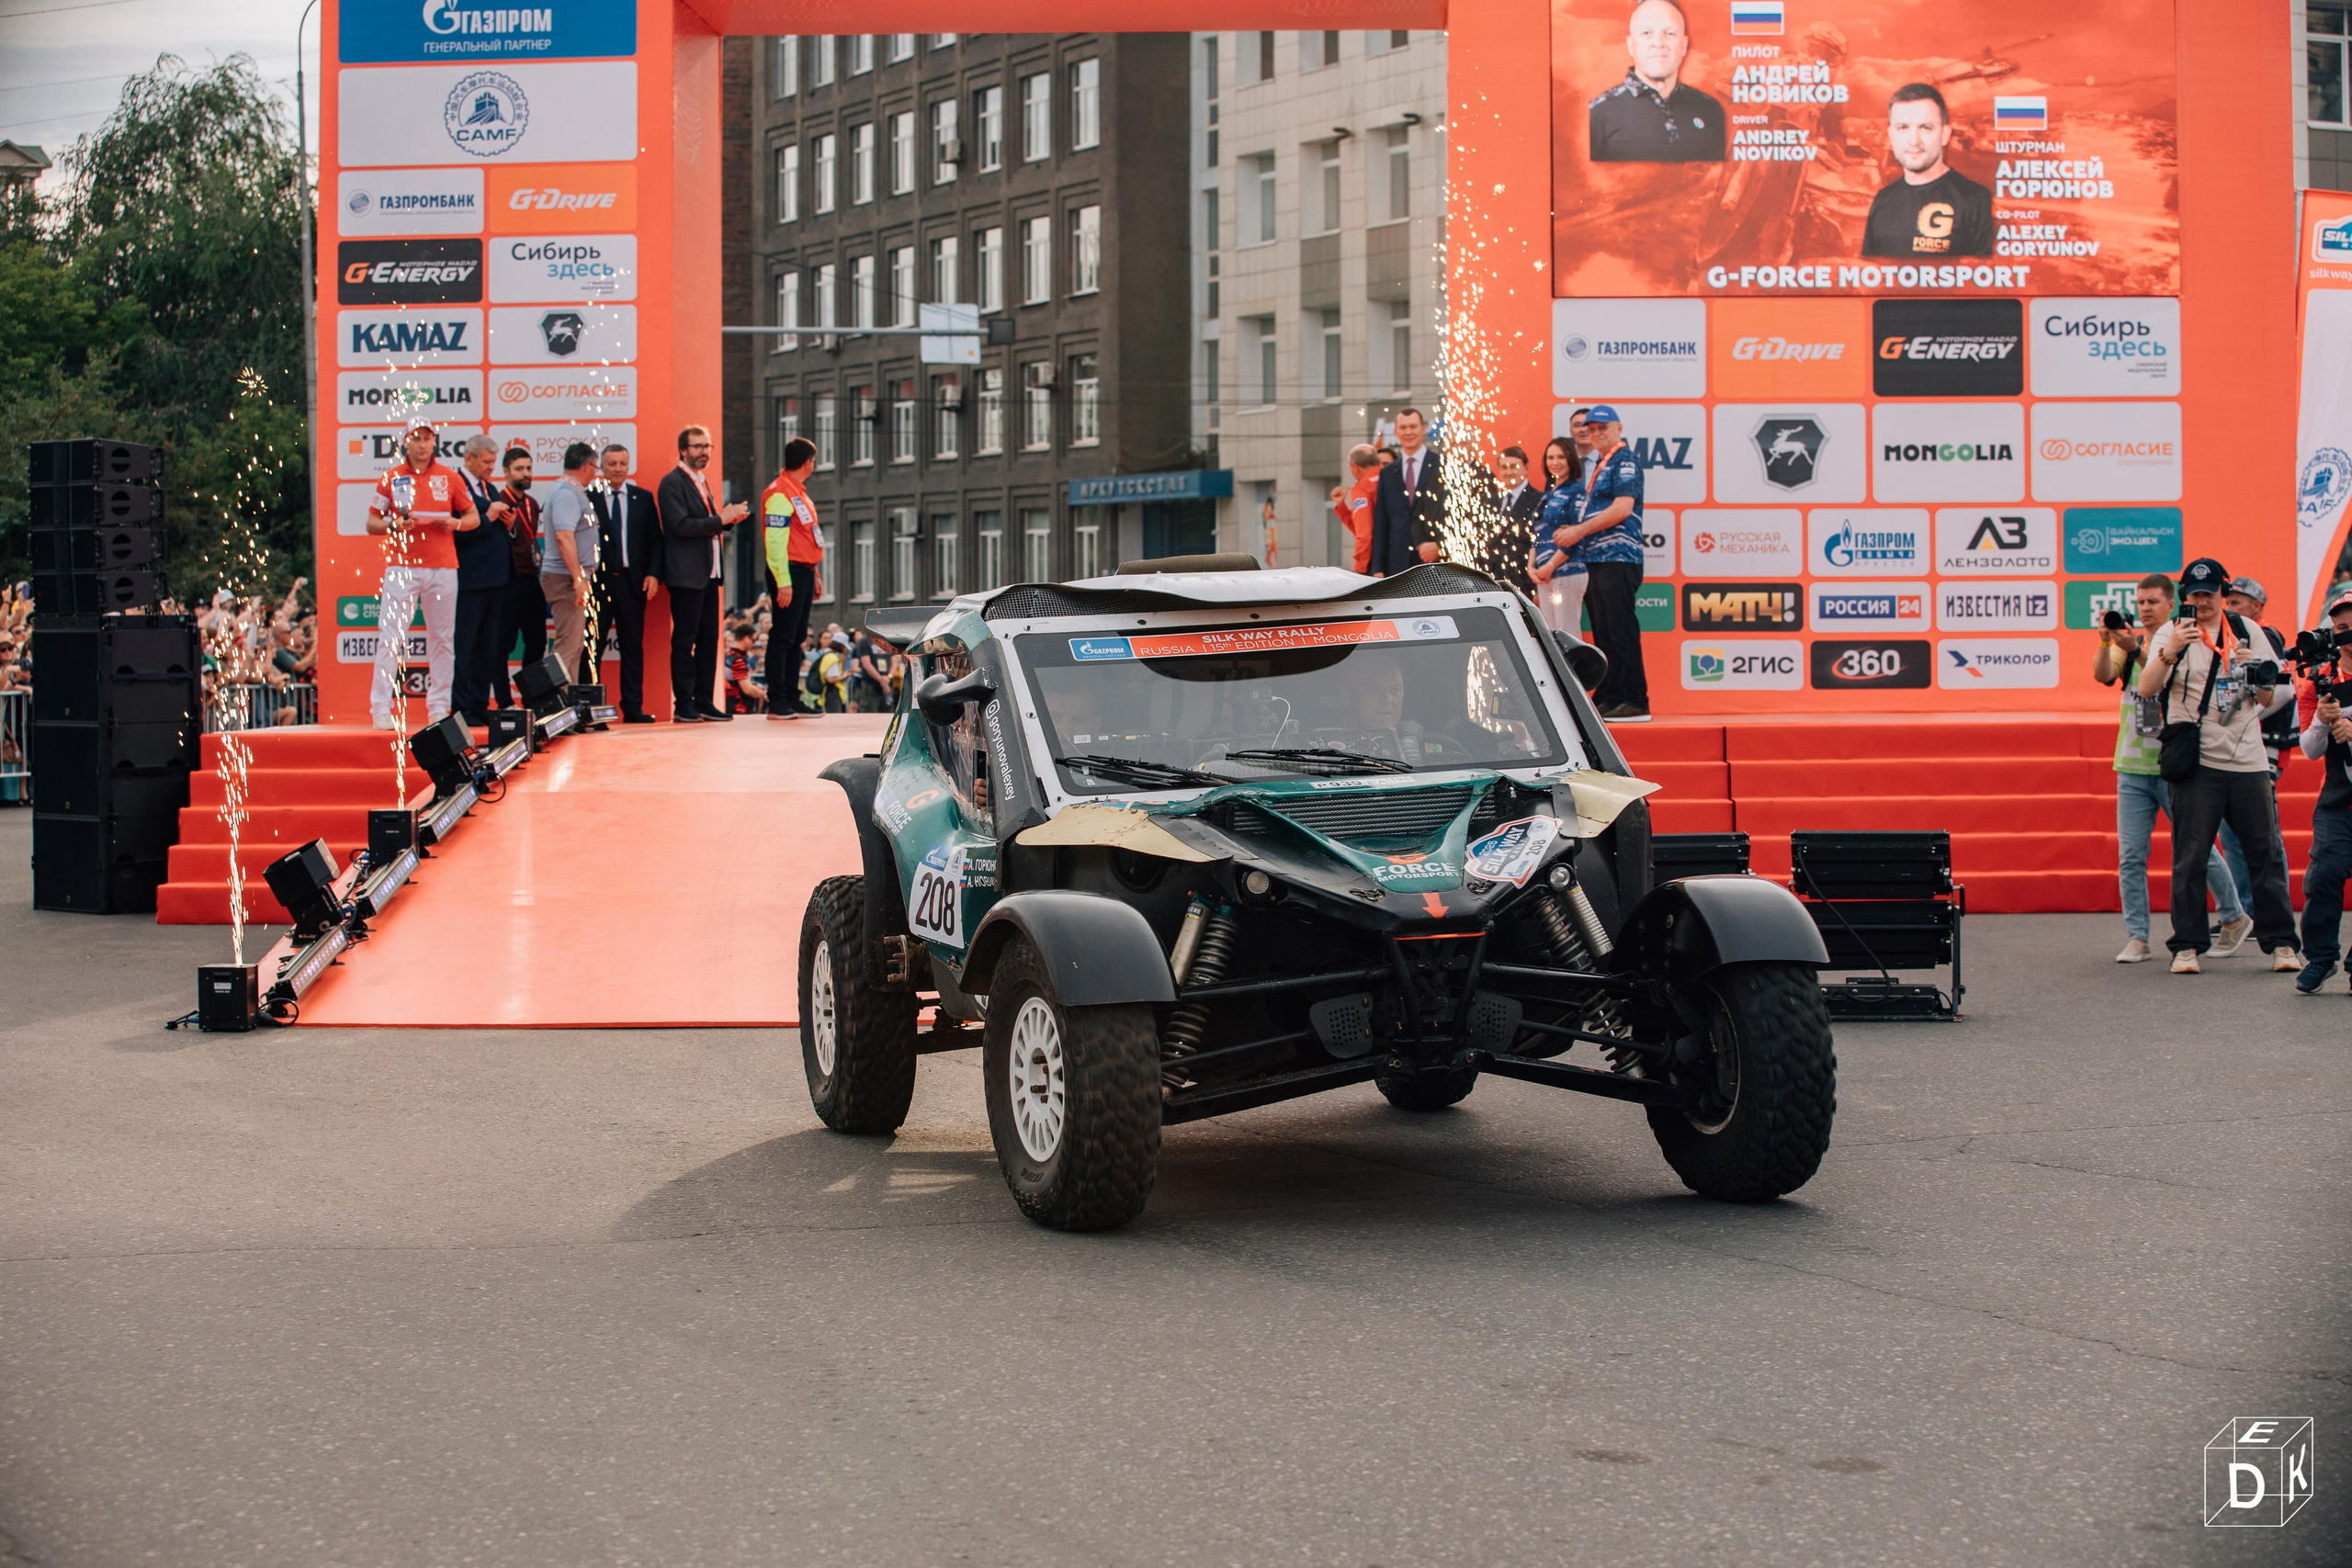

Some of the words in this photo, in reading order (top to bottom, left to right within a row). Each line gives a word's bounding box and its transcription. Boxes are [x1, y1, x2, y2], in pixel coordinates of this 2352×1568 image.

[461, 8, 552, 34] ГАЗПРОМ
[424, 39, 502, 53] ГЕНЕРАЛЬНЫЙ
[504, 39, 551, 51] ПАРТНЕР
[1732, 46, 1781, 58] ПИЛОТ
[1732, 61, 1830, 85] АНДРЕЙ
[1732, 85, 1849, 104] НОВИКОВ
[1732, 116, 1769, 125] DRIVER
[457, 129, 516, 141] CAMF
[1732, 130, 1810, 145] ANDREY
[1732, 146, 1817, 162] NOVIKOV
[1996, 141, 2065, 153] ШТУРМАН
[1996, 156, 2104, 179] АЛЕКСЕЙ
[1996, 180, 2114, 199] ГОРЮНОВ
[379, 195, 475, 209] ГАЗПРОМБАНК
[1996, 210, 2041, 220] CO-PILOT
[1996, 224, 2068, 240] ALEXEY
[2323, 230, 2352, 243] SIL
[1913, 236, 1951, 249] FORCE
[1996, 241, 2099, 256] GORYUNOV
[512, 243, 601, 264] Сибирь
[548, 263, 615, 281] здесь
[1707, 265, 1832, 288] G-FORCE
[1838, 265, 2030, 288] MOTORSPORT
[2044, 315, 2150, 341] Сибирь
[353, 322, 468, 353] KAMAZ
[1598, 342, 1696, 355] ГАЗПРОМБАНК
[2087, 341, 2167, 360] здесь
[348, 387, 471, 405] MONGOLIA
[532, 384, 628, 399] СОГЛАСИЕ
[1621, 437, 1693, 469] MAZ
[1884, 444, 2013, 461] MONGOLIA
[2075, 443, 2174, 457] СОГЛАСИЕ
[1080, 475, 1186, 497] ИРКУТСКСТАТ
[1720, 532, 1781, 542] РУССКАЯ
[2110, 527, 2175, 536] БАЙКАЛЬСК
[1720, 544, 1790, 554] МЕХАНИКА
[1855, 533, 1916, 548] ГАЗПРОМ
[1855, 550, 1915, 559] ДОБЫЧА
[1944, 558, 2051, 568] ЛЕНЗОЛОТО
[1690, 592, 1795, 623] МАТЧ!
[1825, 600, 1890, 615] РОССИЯ
[1899, 599, 1920, 615] 24
[1946, 595, 2021, 617] ИЗВЕСТИЯ
[1202, 633, 1238, 643] SILK
[1238, 631, 1274, 641] WAY
[1278, 626, 1325, 638] RALLY
[1140, 645, 1196, 656] RUSSIA
[1209, 642, 1232, 652] 15th
[1236, 637, 1295, 650] EDITION
[1314, 631, 1395, 644] MONGOLIA
[1732, 656, 1795, 673] 2ГИС
[1842, 649, 1901, 676] 360
[1975, 655, 2052, 665] ТРИКОЛОР
[989, 716, 1015, 801] goryunovalexey
[905, 788, 940, 809] G
[888, 799, 912, 830] FORCE
[1478, 840, 1498, 857] 2025
[1483, 848, 1512, 874] SILK
[1498, 827, 1526, 848] WAY
[1510, 837, 1526, 859] RALLY
[1525, 839, 1547, 856] 208
[975, 858, 997, 872] ГОРЮНО
[1372, 862, 1458, 877] FORCE
[1378, 871, 1464, 882] MOTORSPORT
[915, 872, 956, 936] 208
